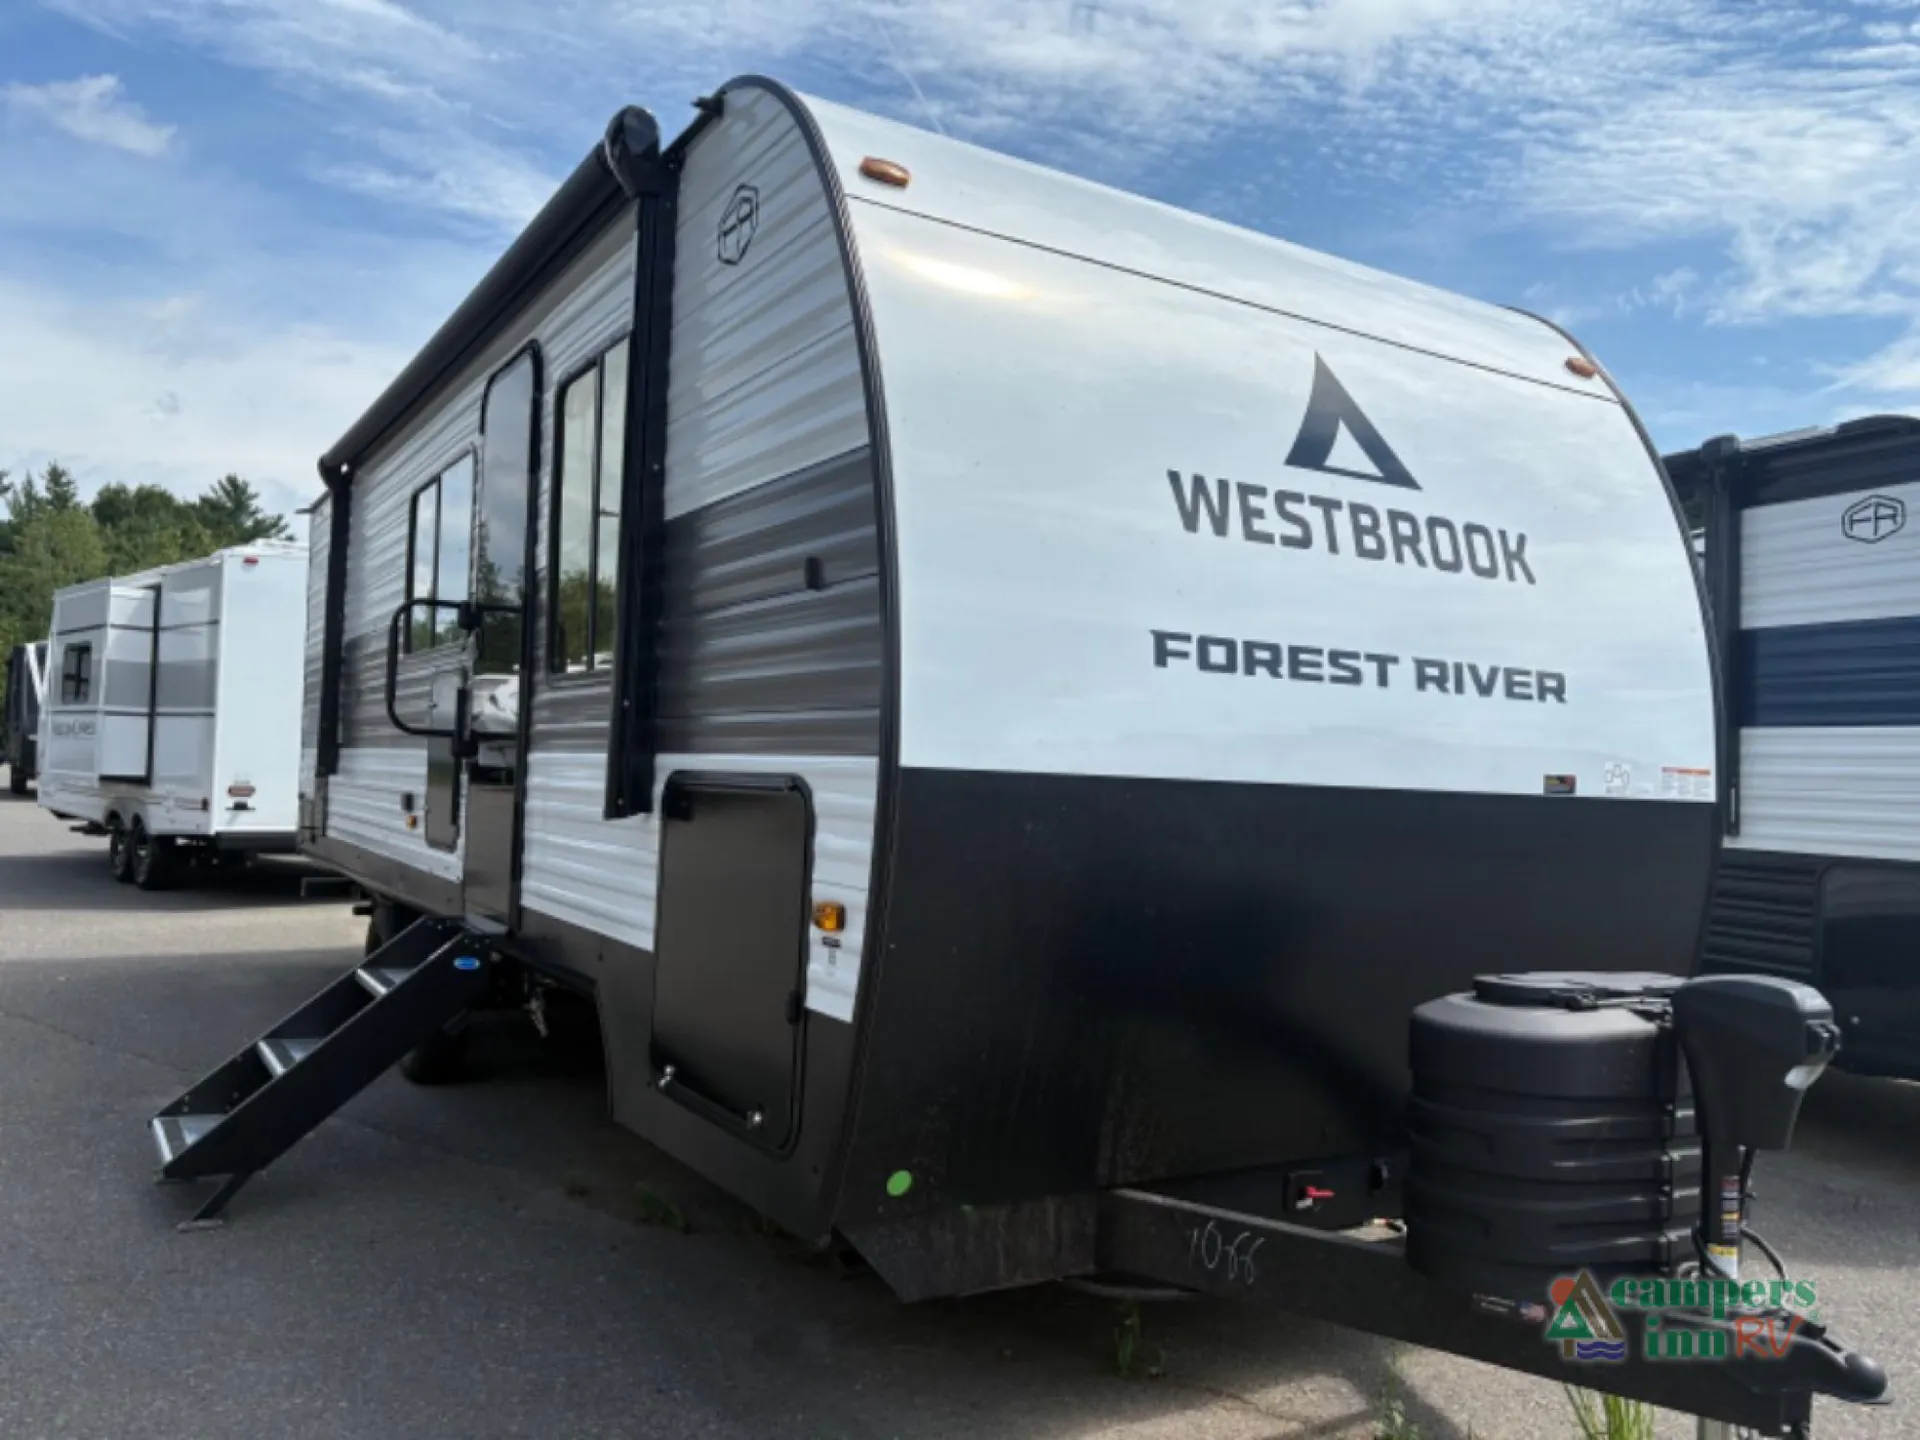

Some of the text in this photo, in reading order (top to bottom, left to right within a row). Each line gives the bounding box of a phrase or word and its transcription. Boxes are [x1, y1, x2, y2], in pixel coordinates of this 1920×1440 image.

[1167, 469, 1536, 585] WESTBROOK
[1149, 629, 1568, 704] FOREST RIVER
